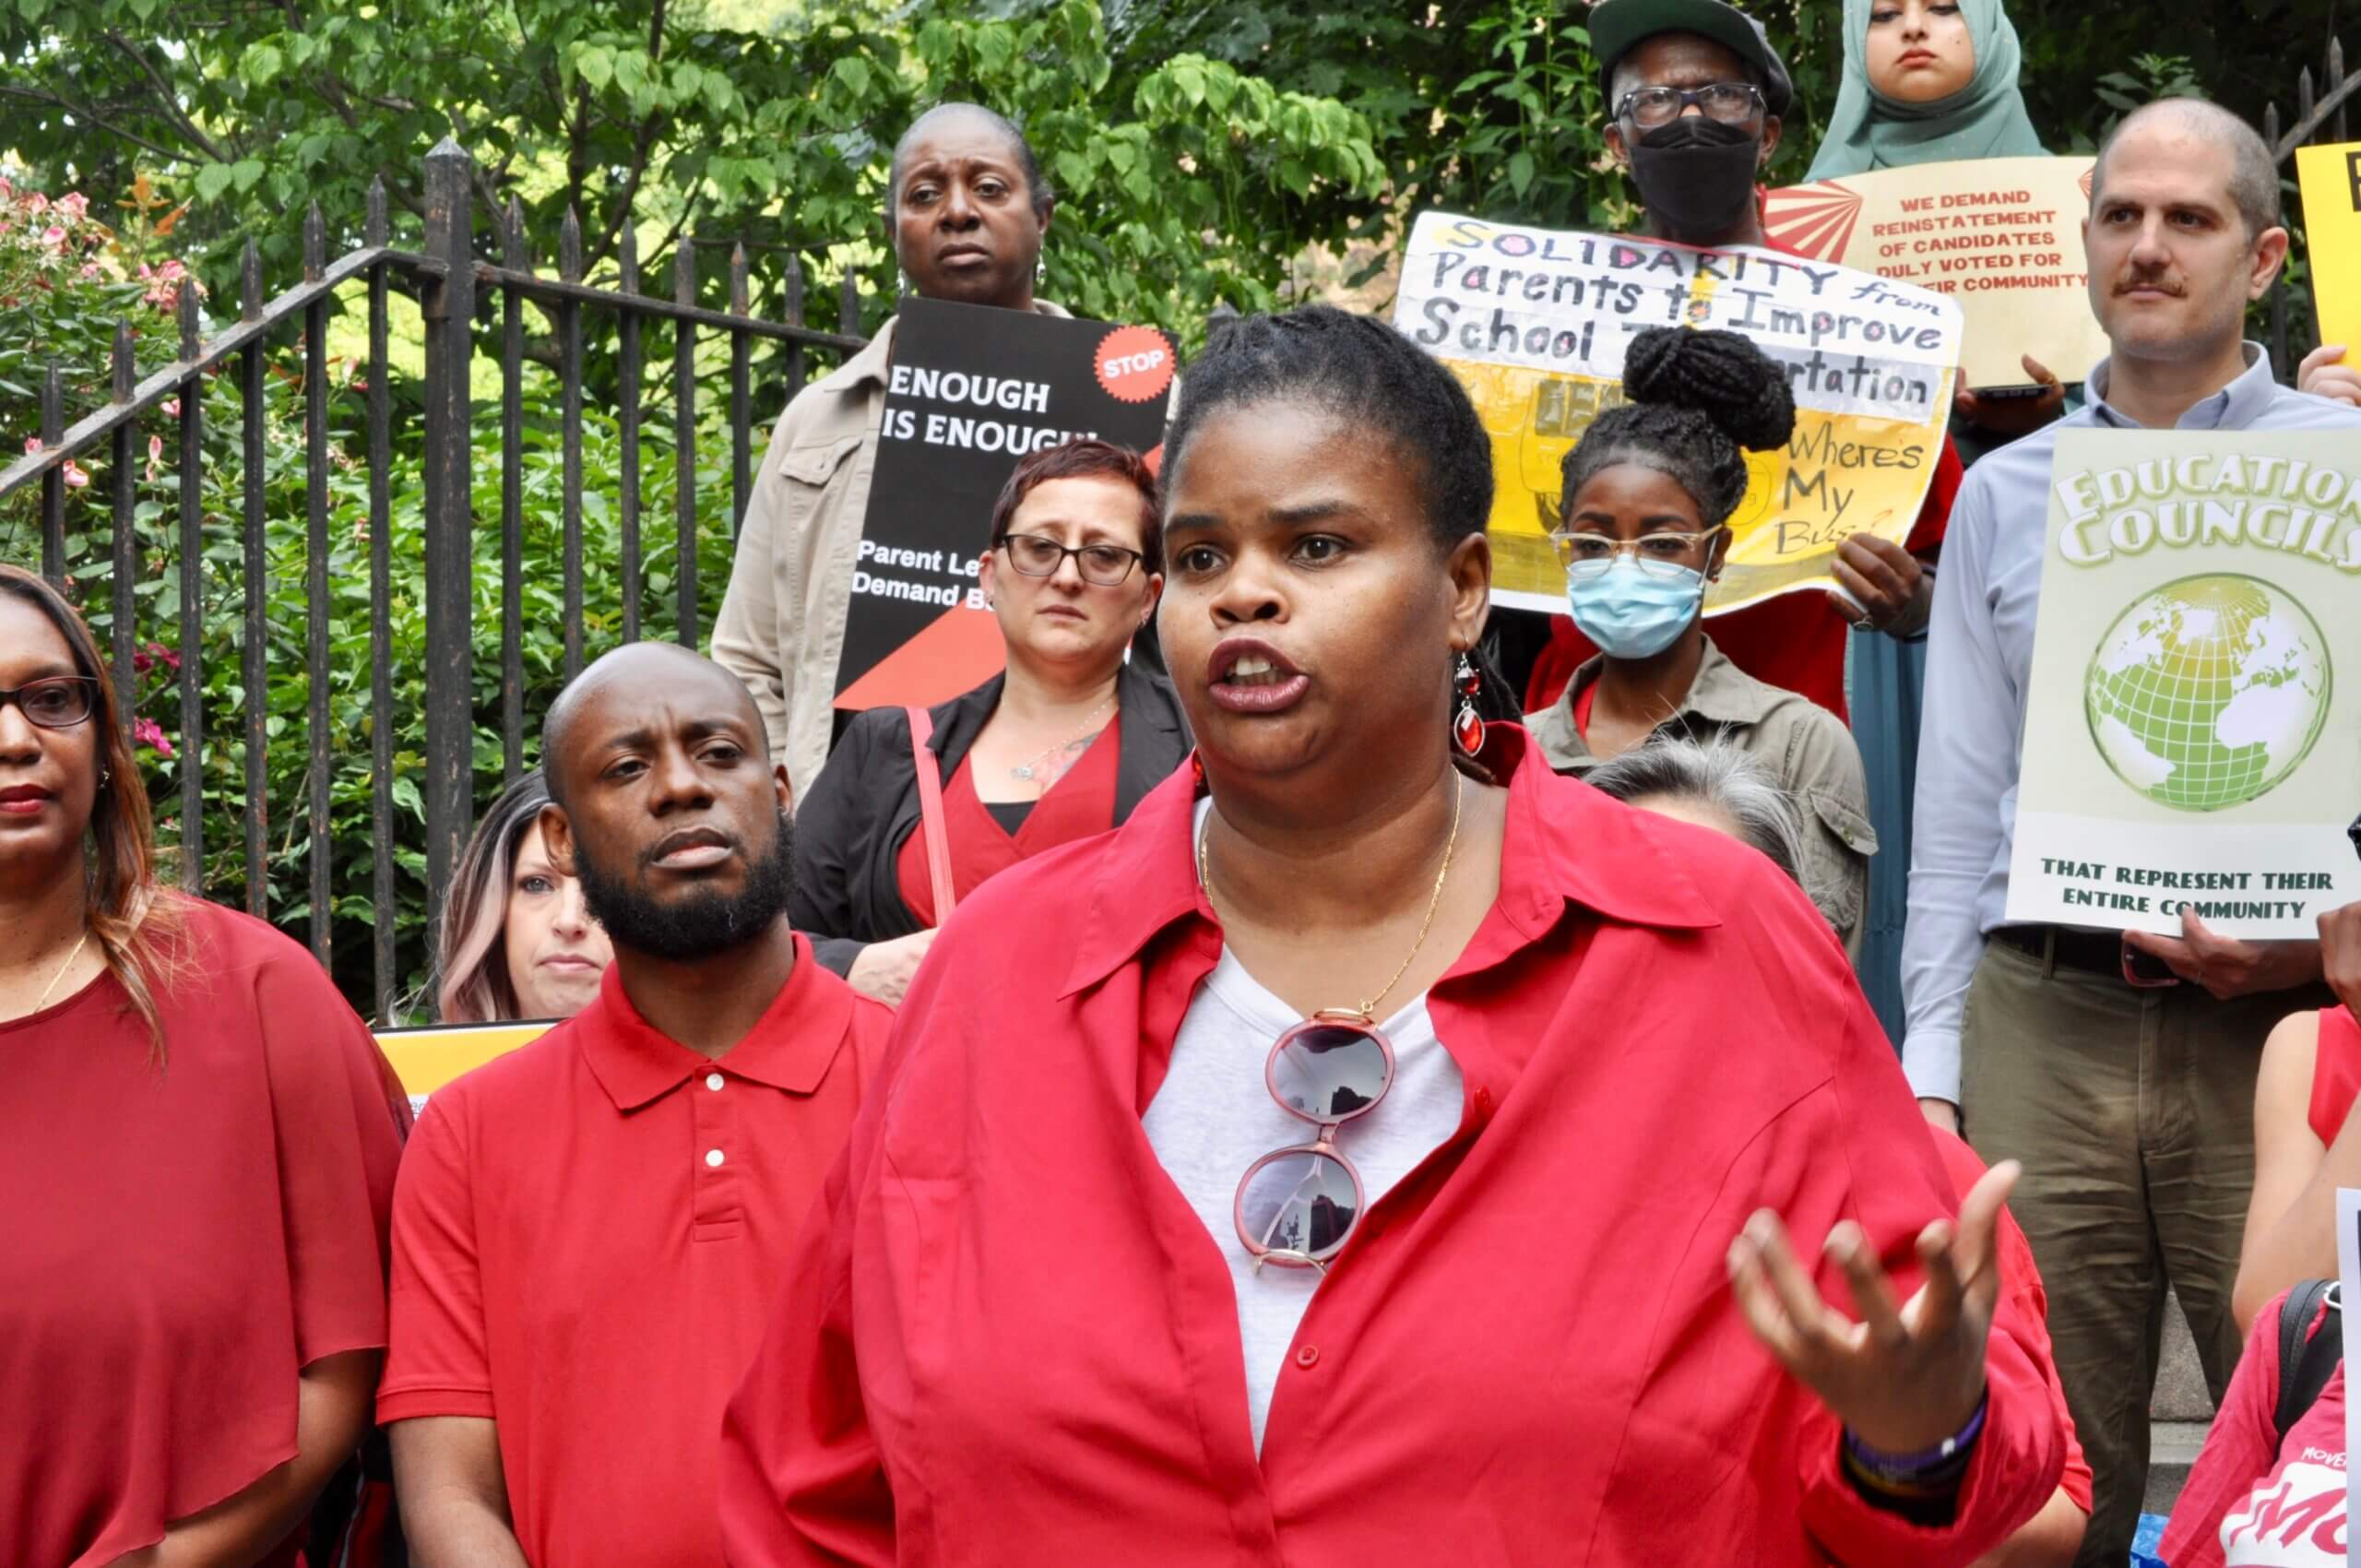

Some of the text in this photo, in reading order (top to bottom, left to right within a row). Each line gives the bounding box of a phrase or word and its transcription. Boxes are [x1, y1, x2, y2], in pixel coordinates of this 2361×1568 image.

[1901, 190, 2031, 212] WE DEMAND
[1872, 210, 2057, 237] REINSTATEMENT
[1879, 232, 2056, 257] OF CANDIDATES
[1447, 220, 1940, 316] SOLIDARITY from
[1877, 253, 2062, 279] DULY VOTED FOR
[1916, 274, 2088, 294] EIR COMMUNITY
[1430, 251, 1941, 350] Parents to Improve
[1416, 296, 1596, 362] School
[1103, 349, 1166, 379] STOP
[888, 365, 1051, 413] ENOUGH
[882, 409, 1098, 456] IS ENOUG
[1783, 466, 1855, 532] My
[857, 540, 943, 572] Parent
[851, 571, 960, 606] Demand
[2041, 858, 2333, 890] THAT REPRESENT THEIR
[2063, 887, 2151, 913] ENTIRE
[2301, 1445, 2346, 1467] MOVE
